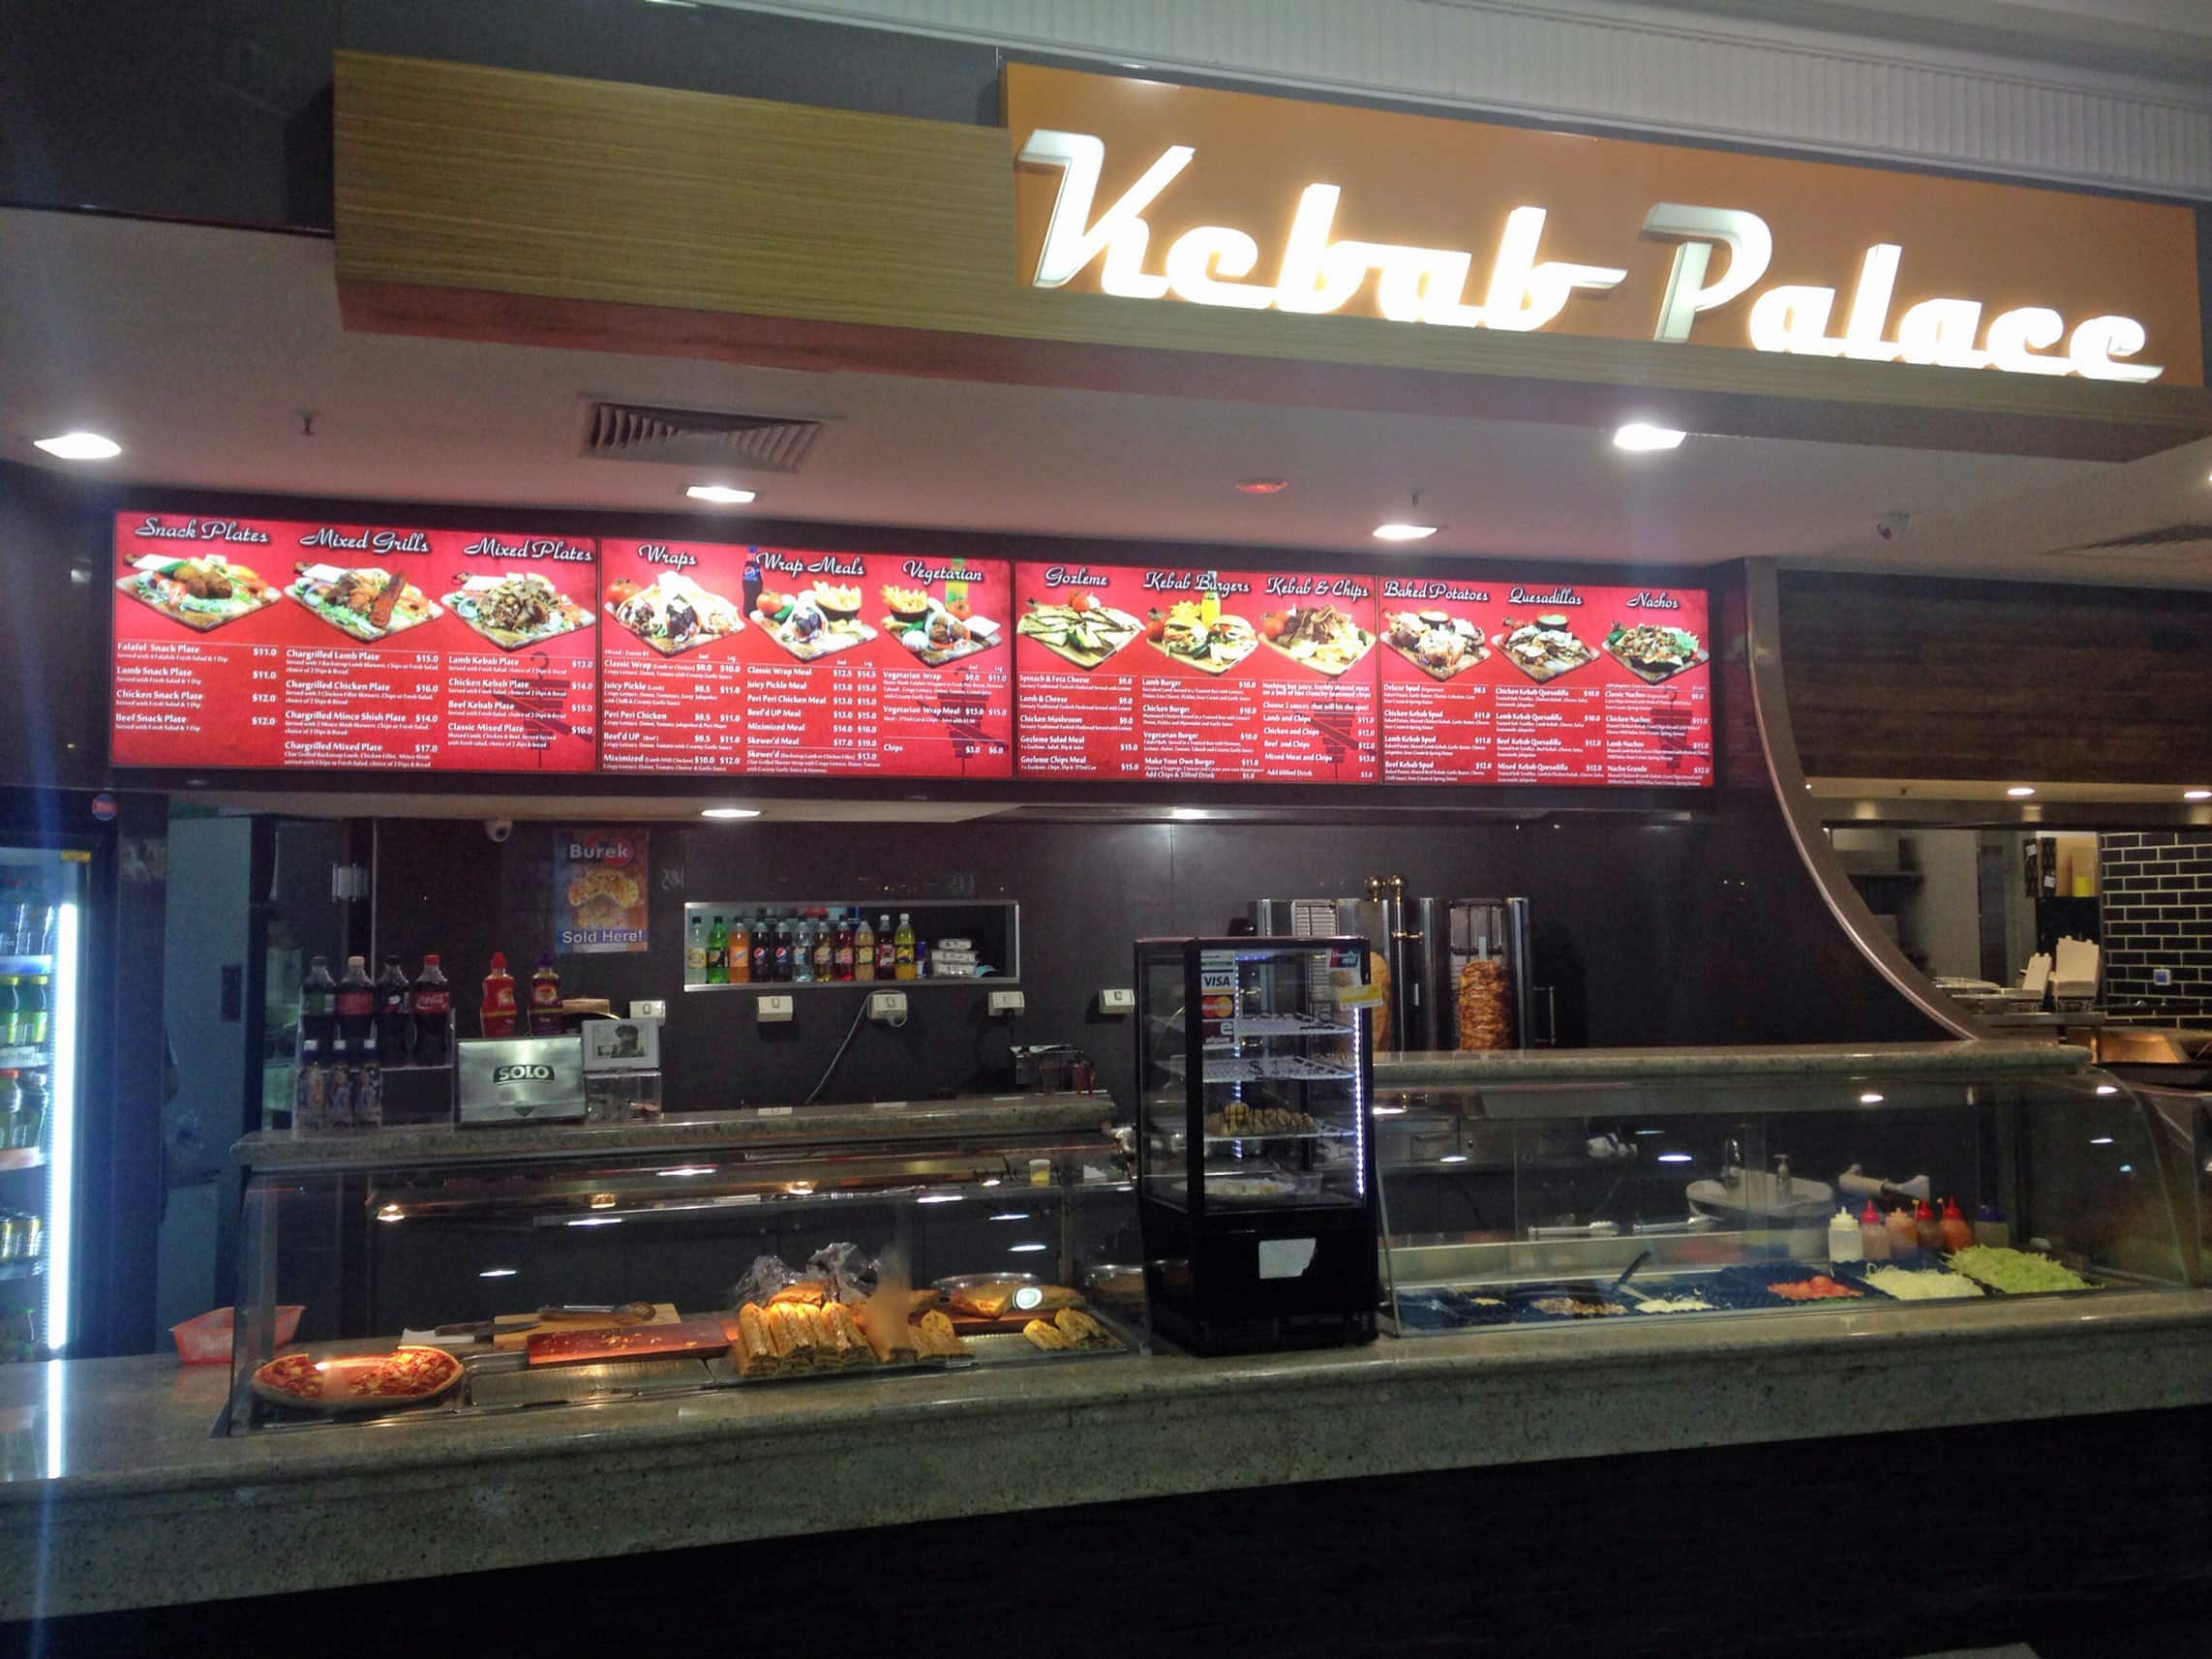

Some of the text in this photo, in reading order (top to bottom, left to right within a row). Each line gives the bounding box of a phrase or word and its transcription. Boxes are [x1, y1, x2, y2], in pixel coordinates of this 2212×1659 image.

[1016, 130, 2164, 382] Kebab Palace
[135, 518, 268, 543] Snack Plates
[300, 528, 429, 554] Mixed Grills
[464, 537, 592, 560] Mixed Plates
[639, 544, 696, 567] Wraps
[757, 553, 864, 576] Wrap Meals
[902, 560, 983, 585] Vegetarian
[1045, 566, 1107, 587] Gozleme
[1143, 572, 1249, 596] Kebab Burgers
[1266, 578, 1369, 603] Kebab & Chips
[1384, 582, 1488, 601] Baked Potatoes
[1508, 588, 1582, 605] Quesadillas
[1626, 593, 1678, 609] Nachos
[118, 643, 199, 653] Falafel Snack Plate
[287, 649, 332, 661] Chargrilled
[359, 652, 379, 661] Plate
[631, 660, 651, 671] Wrap
[773, 667, 792, 677] Wrap
[170, 668, 193, 677] Plate
[924, 673, 941, 681] Wrap
[287, 679, 389, 691] Chargrilled Chicken Plate
[604, 681, 621, 691] Juicy
[747, 681, 764, 690] Juicy
[116, 690, 151, 699] Chicken
[252, 694, 275, 703] $12.0
[286, 711, 331, 722] Chargrilled
[884, 706, 920, 714] Vegetarian
[924, 707, 941, 715] Wrap
[285, 741, 331, 752] Chargrilled
[884, 744, 902, 753] Chips
[569, 844, 628, 858] Burek
[562, 929, 643, 944] Sold Here!
[1204, 976, 1230, 986] VISA
[499, 1066, 549, 1080] SOLO
